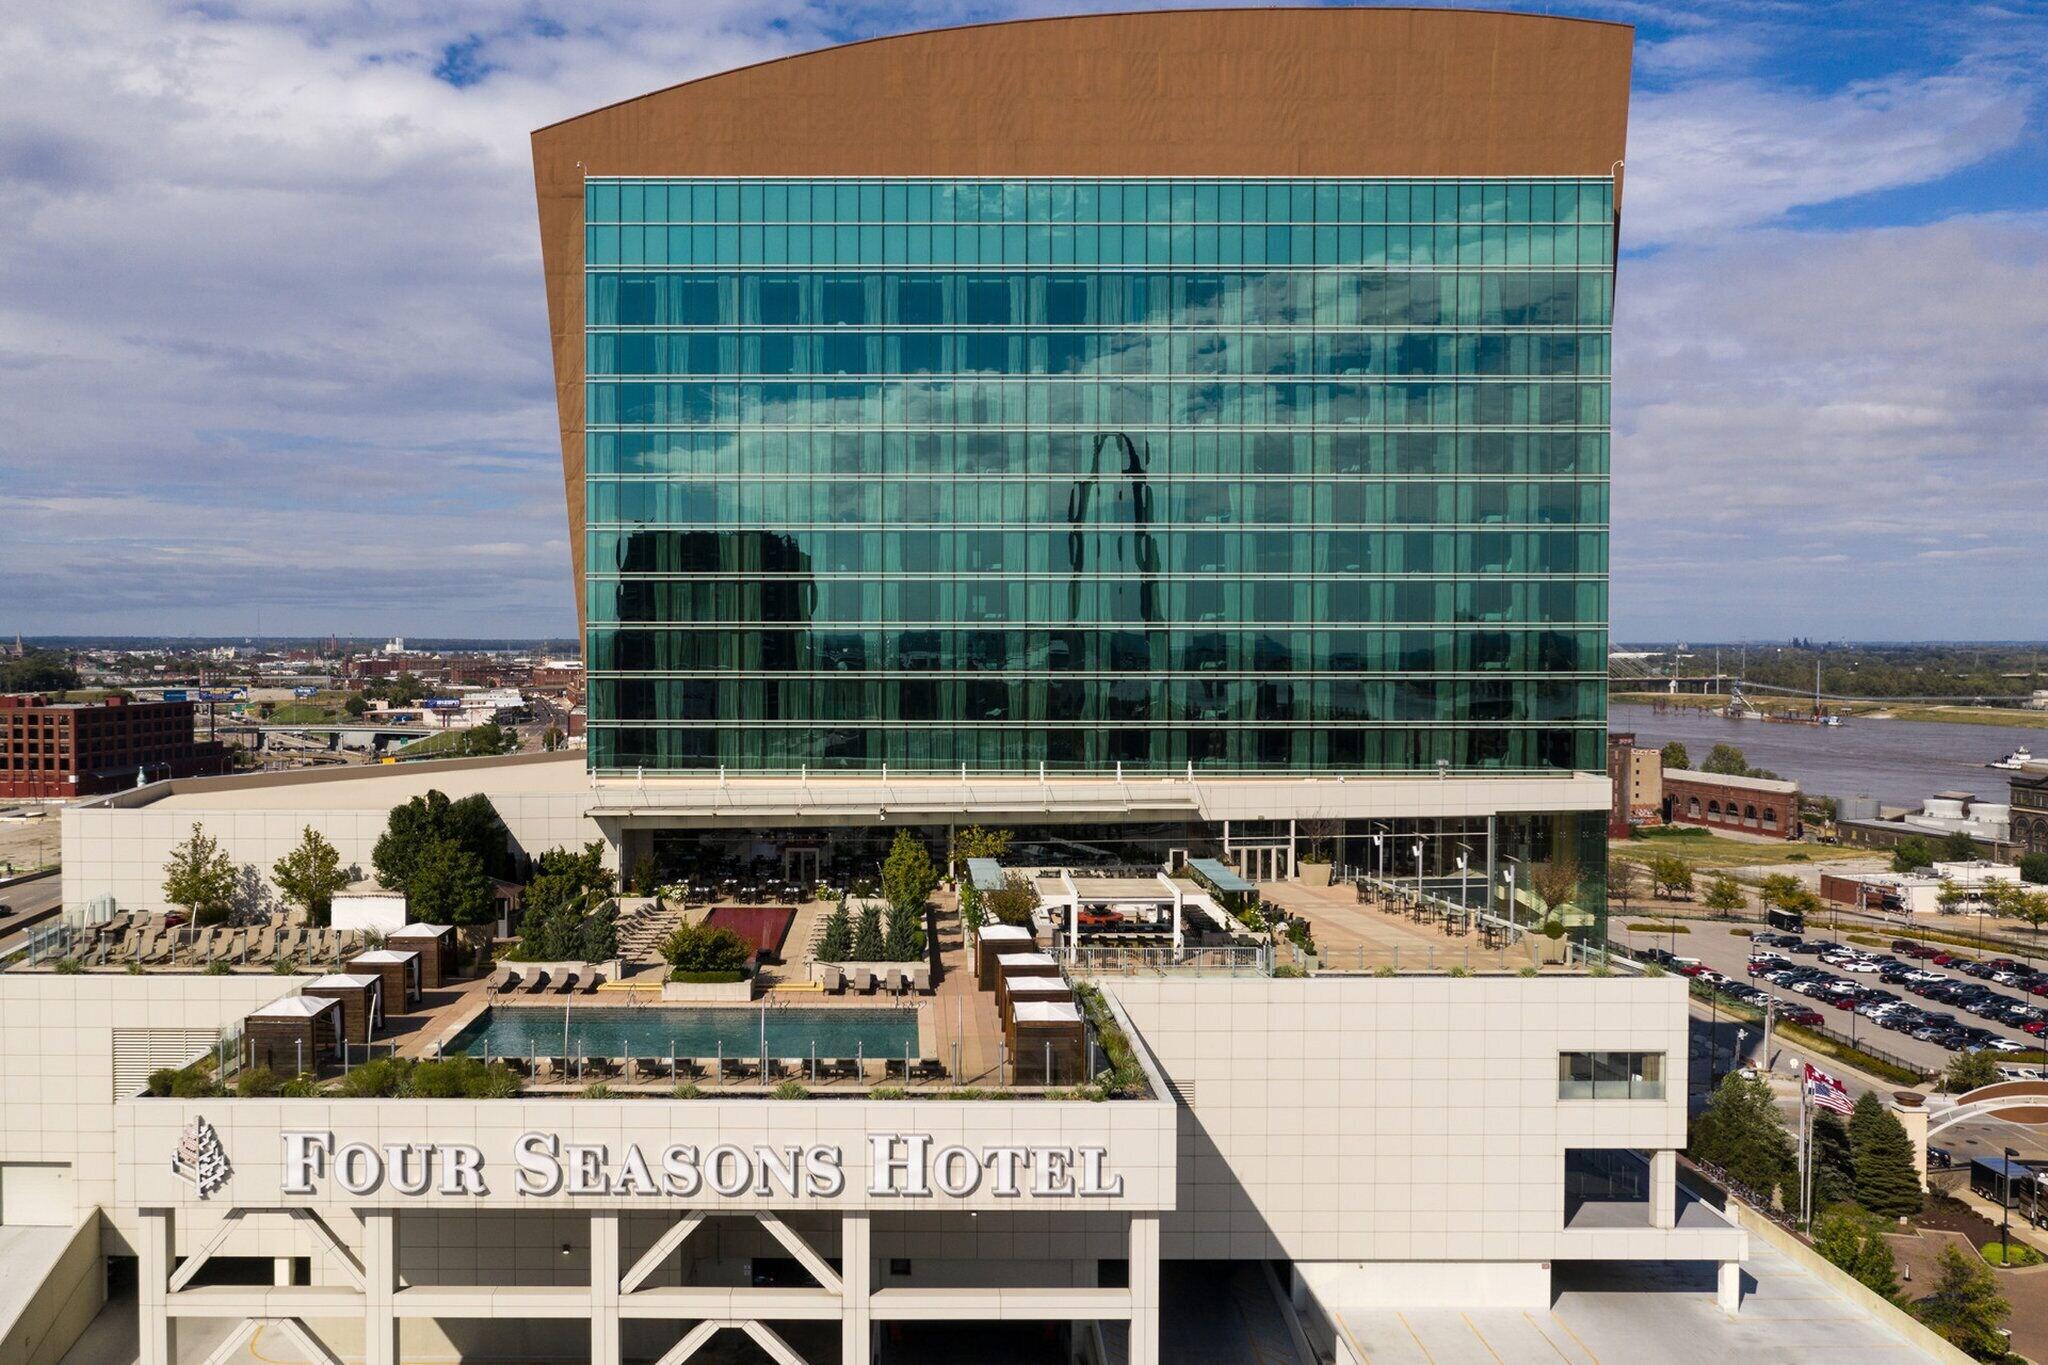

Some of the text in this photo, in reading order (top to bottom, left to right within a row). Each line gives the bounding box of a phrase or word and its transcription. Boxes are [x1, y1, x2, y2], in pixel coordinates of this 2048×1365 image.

[281, 1130, 1124, 1197] FOUR SEASONS HOTEL
